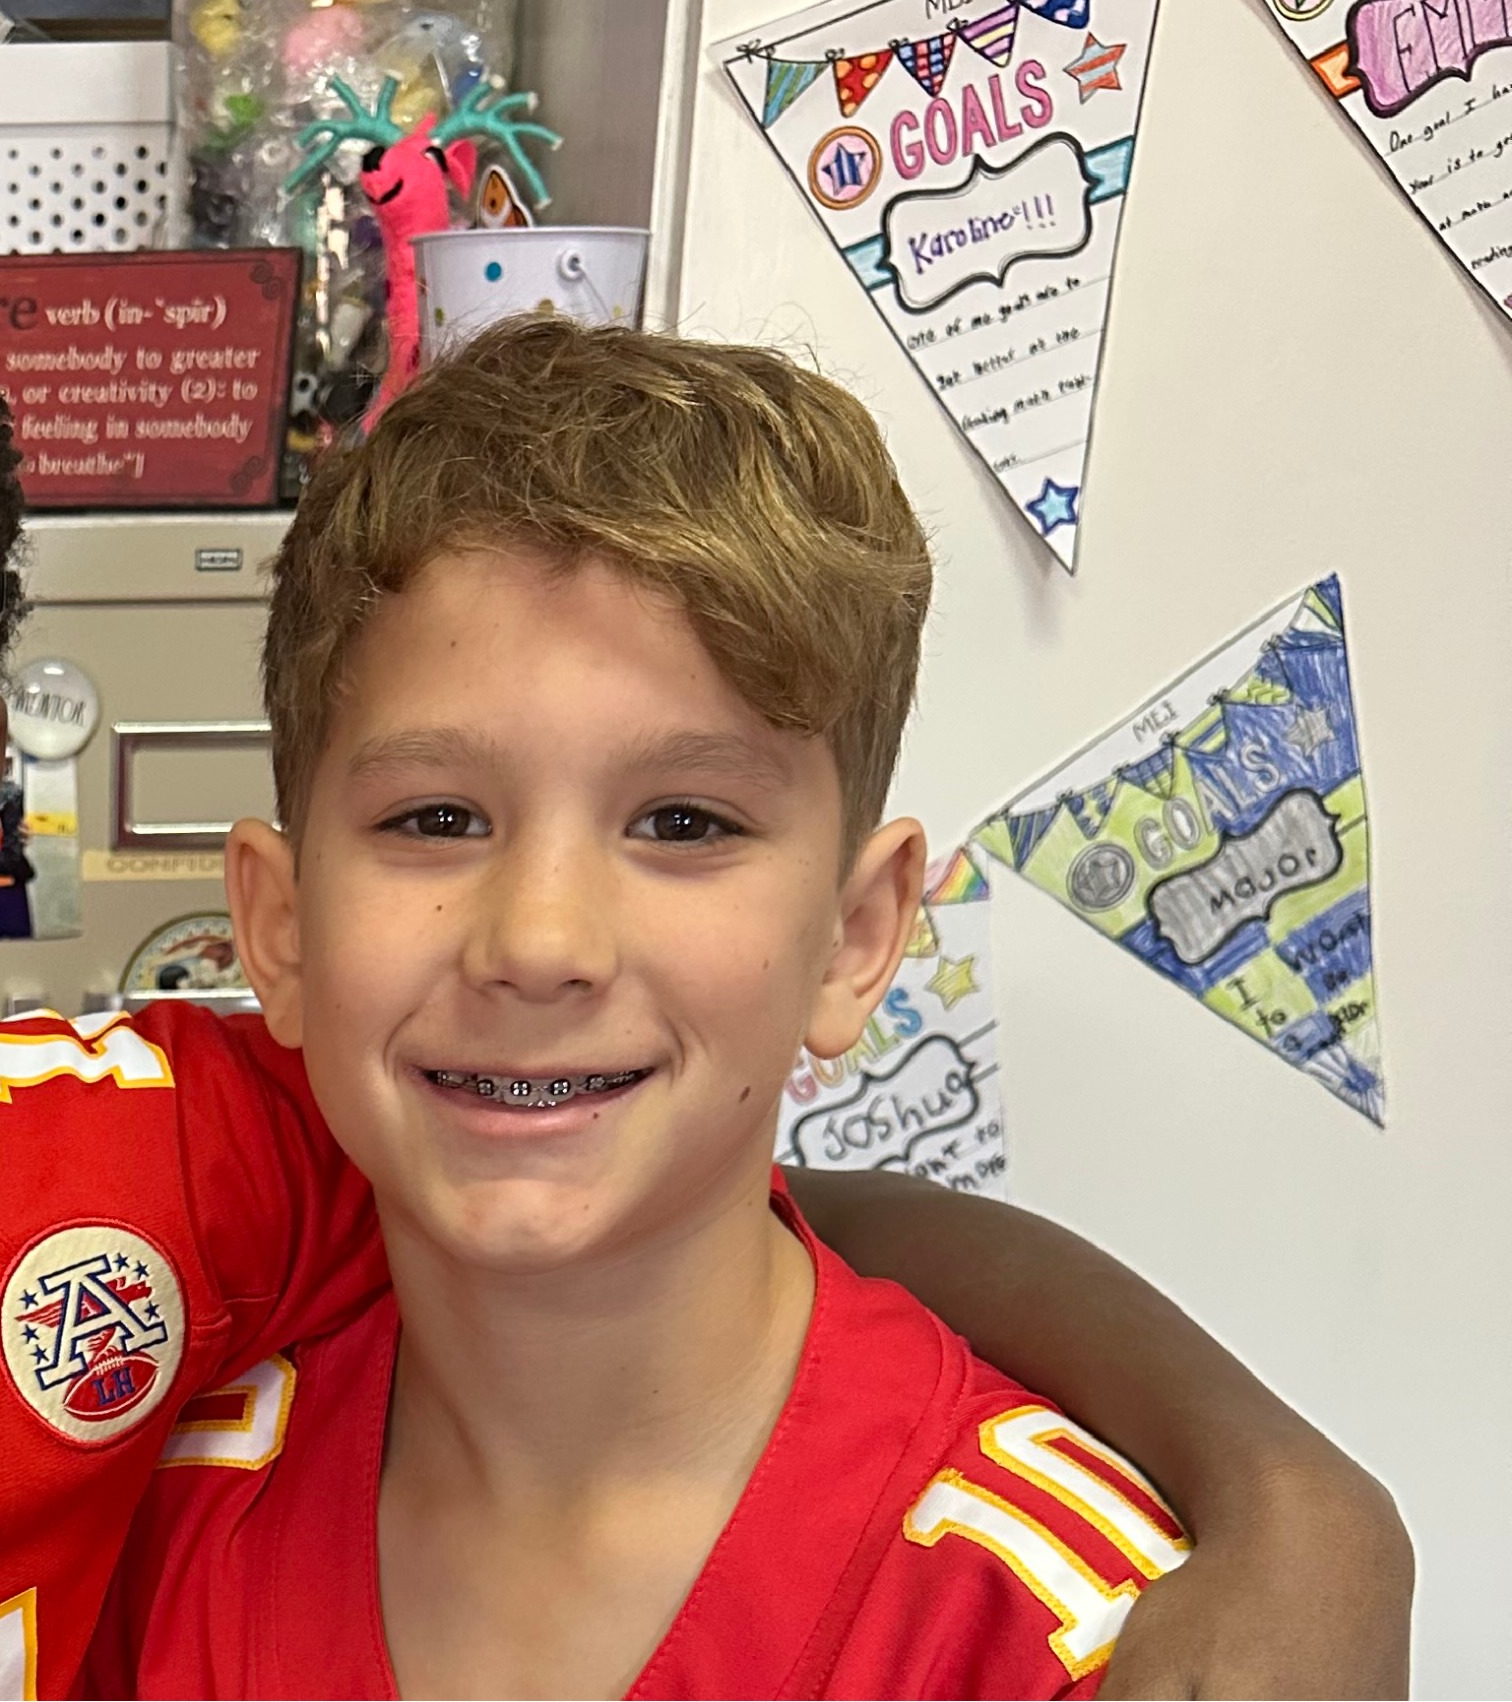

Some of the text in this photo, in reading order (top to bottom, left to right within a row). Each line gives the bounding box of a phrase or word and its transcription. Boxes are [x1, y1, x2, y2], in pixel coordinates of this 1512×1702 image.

[890, 59, 1054, 180] GOALS
[1424, 111, 1450, 141] goal
[45, 298, 100, 326] verb
[5, 345, 127, 374] somebody
[136, 346, 162, 370] to
[170, 347, 261, 374] greater
[22, 386, 50, 404] or
[59, 377, 173, 408] creativity
[232, 379, 259, 401] to
[21, 414, 254, 444] feeling in somebody
[14, 686, 85, 727] MENTOR
[1133, 740, 1281, 872] GOALS
[108, 855, 226, 874] CONFID
[92, 1365, 137, 1408] LH
